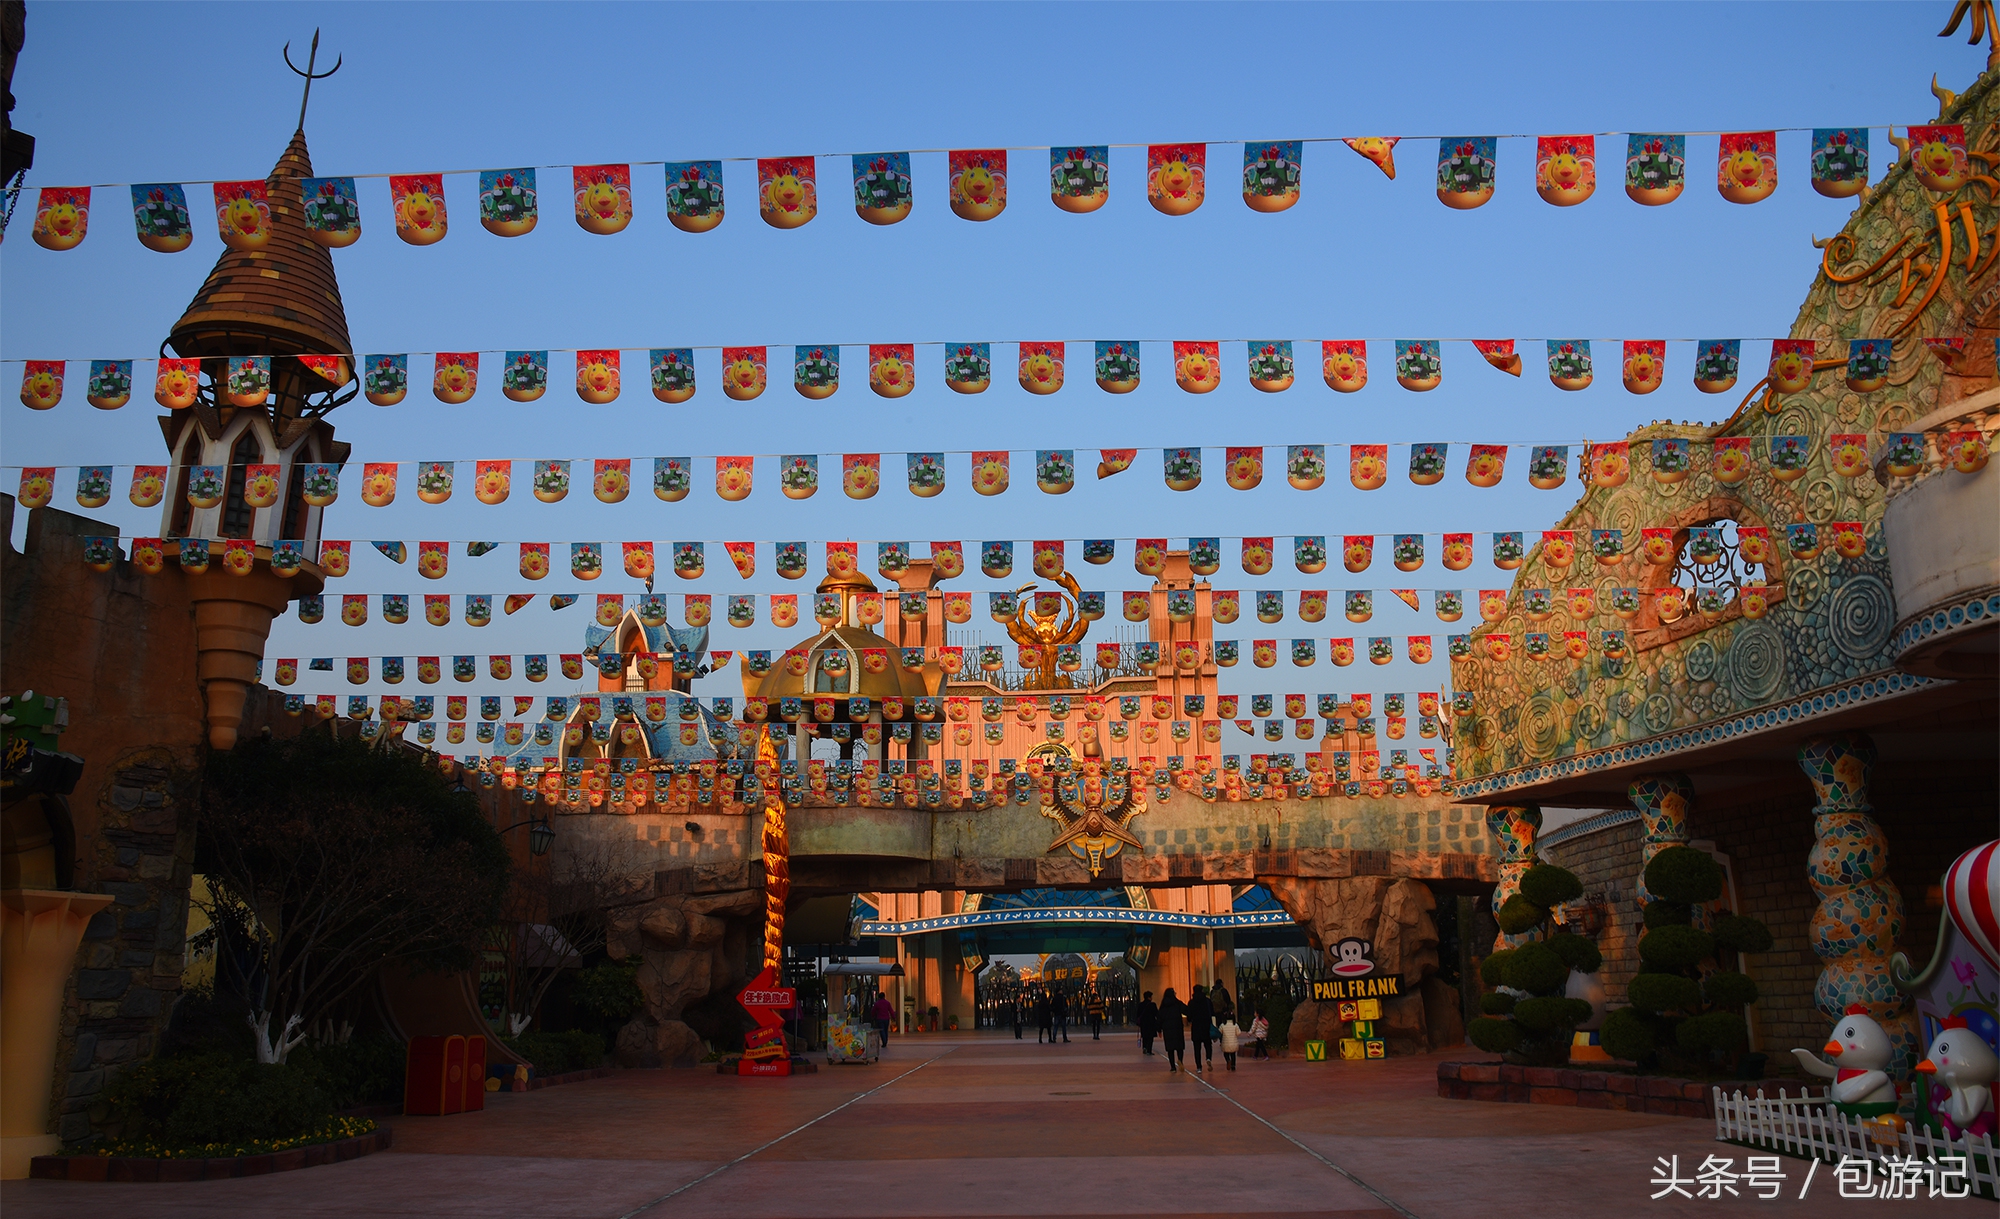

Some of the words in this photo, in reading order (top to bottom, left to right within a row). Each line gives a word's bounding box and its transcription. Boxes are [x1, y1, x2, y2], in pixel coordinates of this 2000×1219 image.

[1313, 980, 1346, 1000] PAUL
[1348, 977, 1399, 997] FRANK
[744, 991, 790, 1005] 年卡换购点
[1358, 1021, 1371, 1038] J
[1308, 1043, 1323, 1060] V
